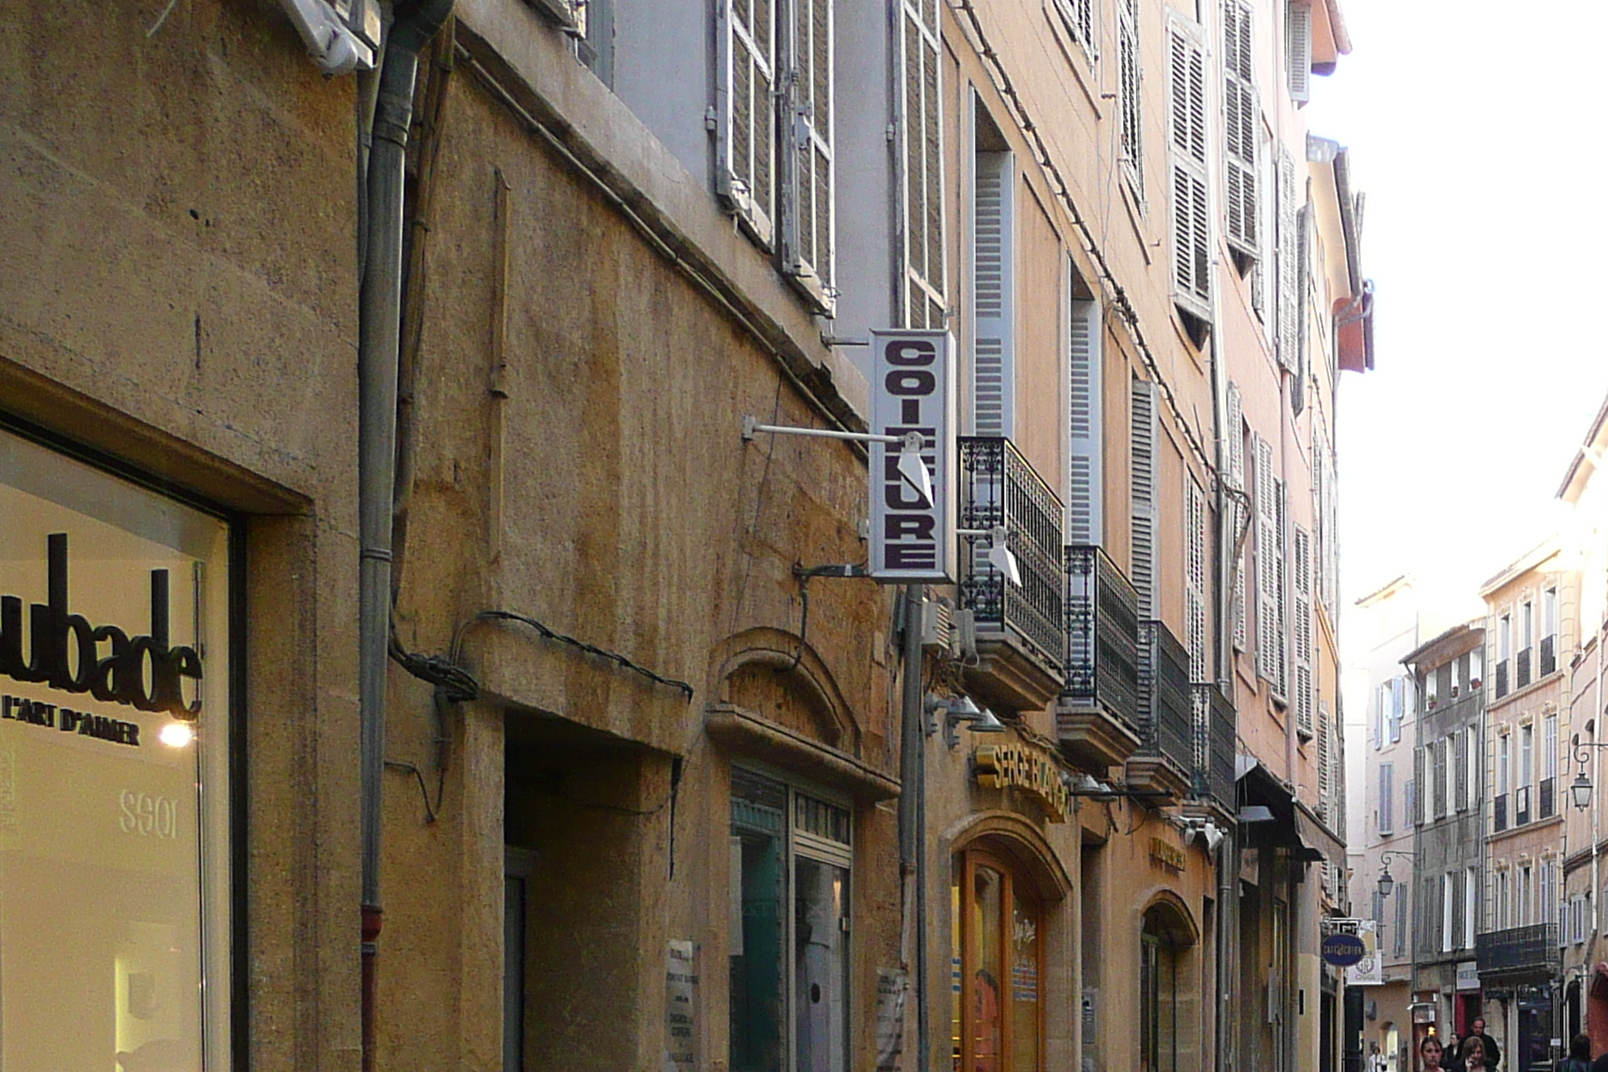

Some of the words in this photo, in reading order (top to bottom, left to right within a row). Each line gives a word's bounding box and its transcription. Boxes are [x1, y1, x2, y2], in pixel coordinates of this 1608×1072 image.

[885, 340, 936, 569] COIFFURE
[0, 533, 203, 721] ubade
[990, 743, 1033, 789] SERGE
